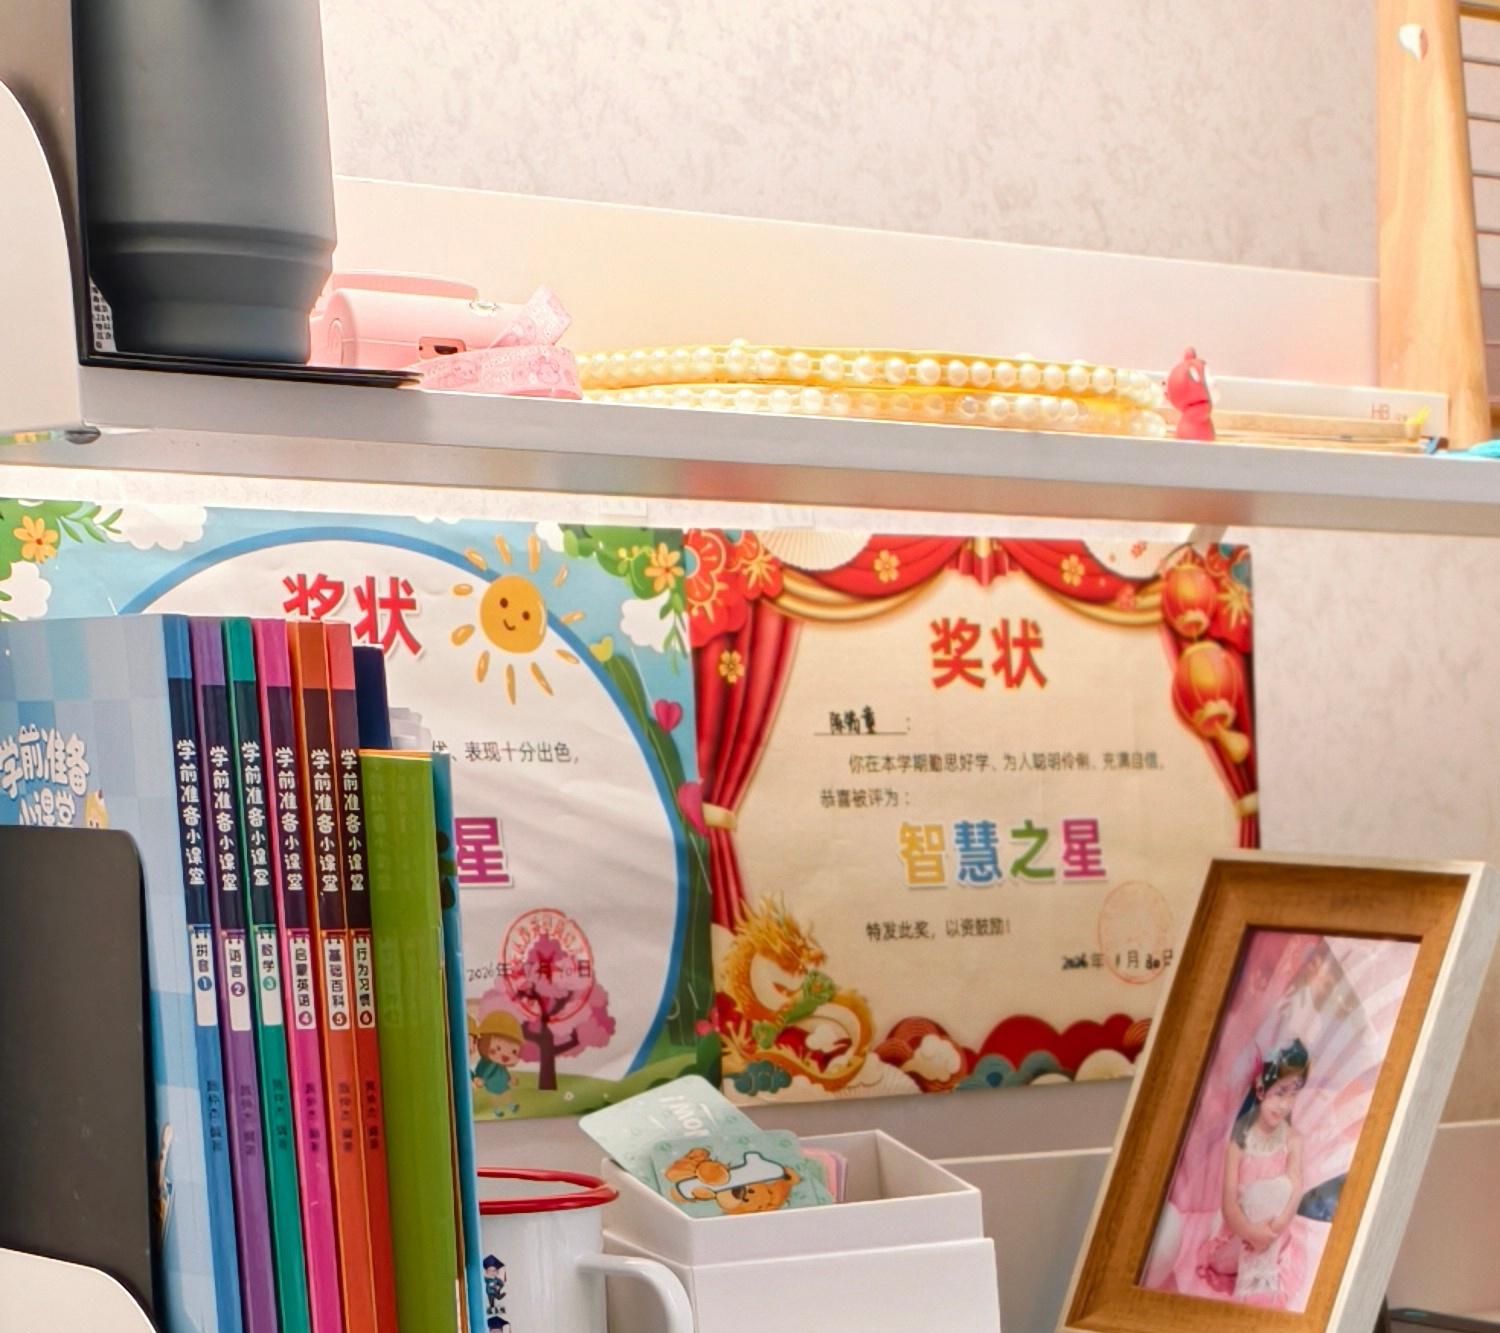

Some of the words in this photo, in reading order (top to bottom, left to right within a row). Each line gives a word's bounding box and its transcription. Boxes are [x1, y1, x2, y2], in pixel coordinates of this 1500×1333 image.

[283, 574, 421, 655] 奖状
[930, 617, 1048, 689] 奖状
[176, 739, 205, 885] 学前准备小课堂
[209, 746, 238, 891] 学前准备小课堂
[241, 740, 269, 886] 学前准备小课堂
[275, 747, 303, 891] 学前准备小课堂
[311, 749, 339, 892] 学前准备小课堂
[341, 749, 364, 891] 学前准备小课堂
[454, 817, 510, 883] 星
[900, 818, 1107, 888] 智慧之星
[658, 1096, 710, 1137] OW!
